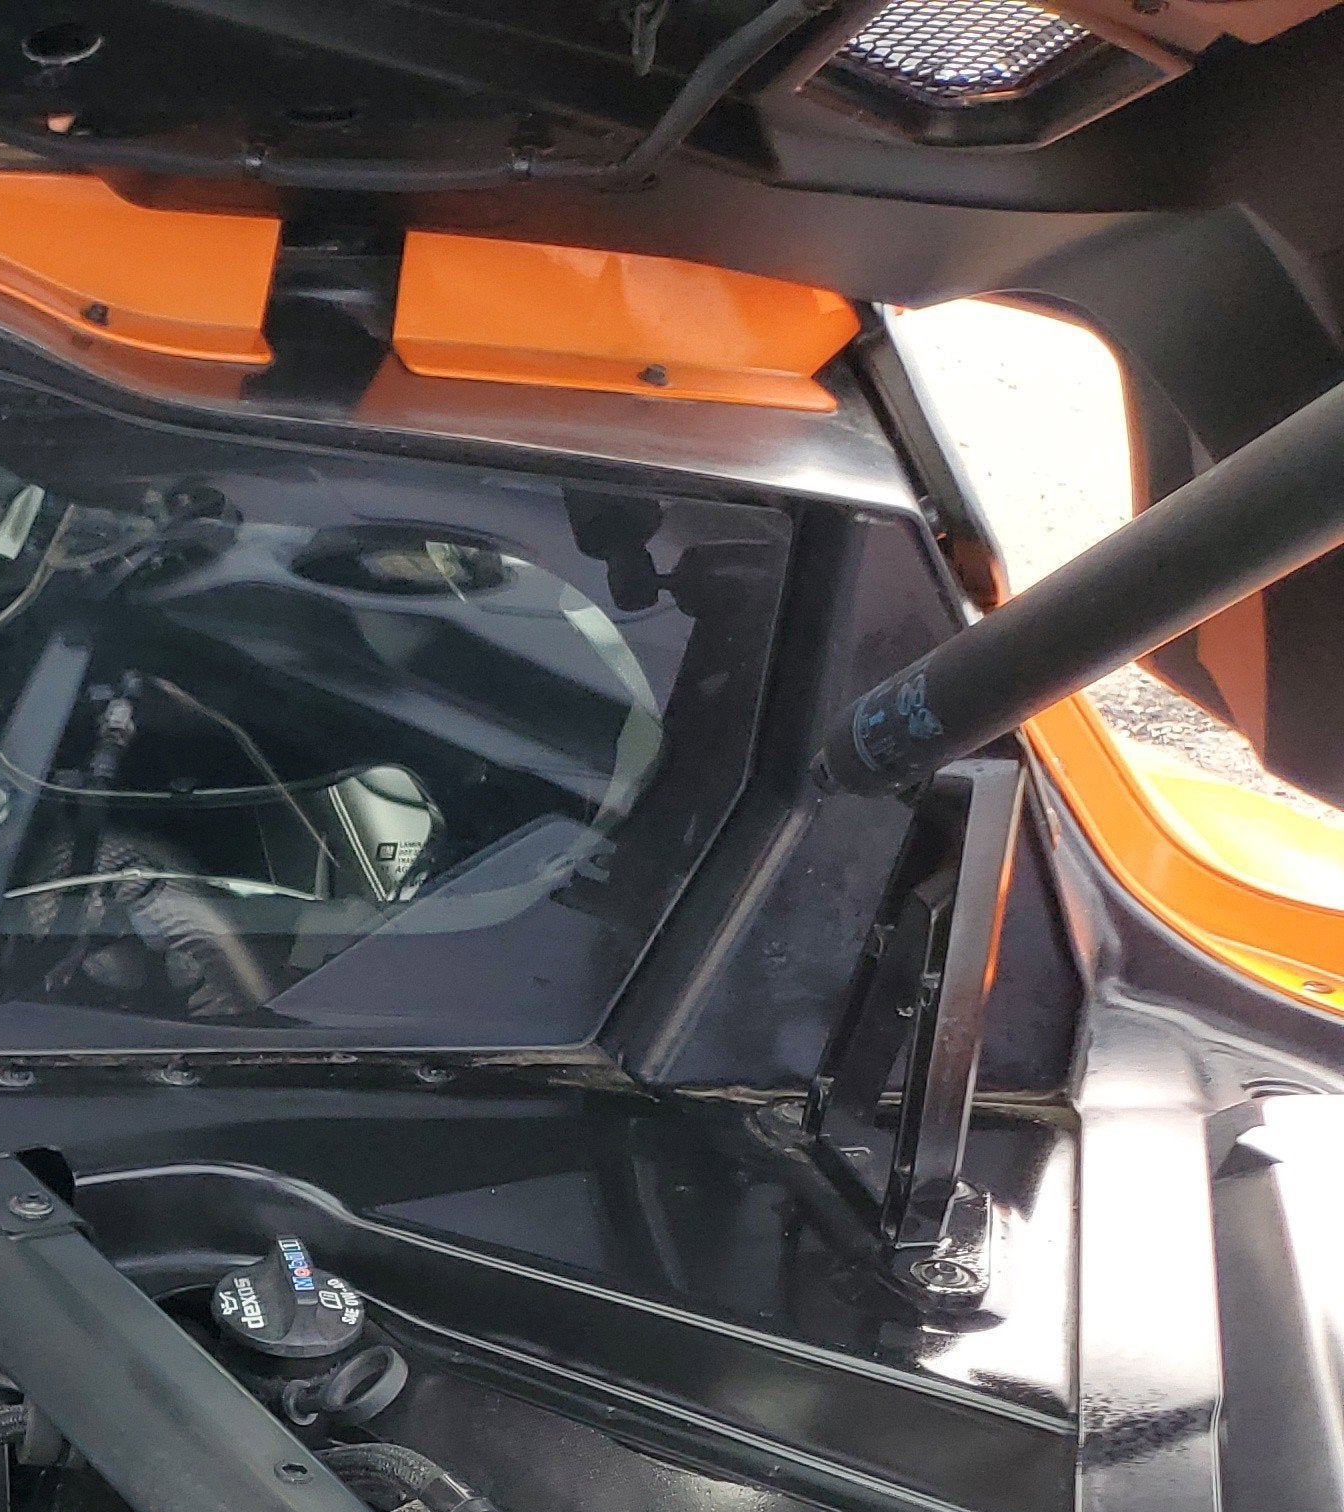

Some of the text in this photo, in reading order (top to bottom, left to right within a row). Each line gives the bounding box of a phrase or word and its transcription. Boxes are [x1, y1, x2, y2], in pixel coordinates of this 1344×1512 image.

[284, 1251, 314, 1290] Mobil
[234, 1277, 264, 1328] dexos
[341, 1307, 360, 1325] SAE
